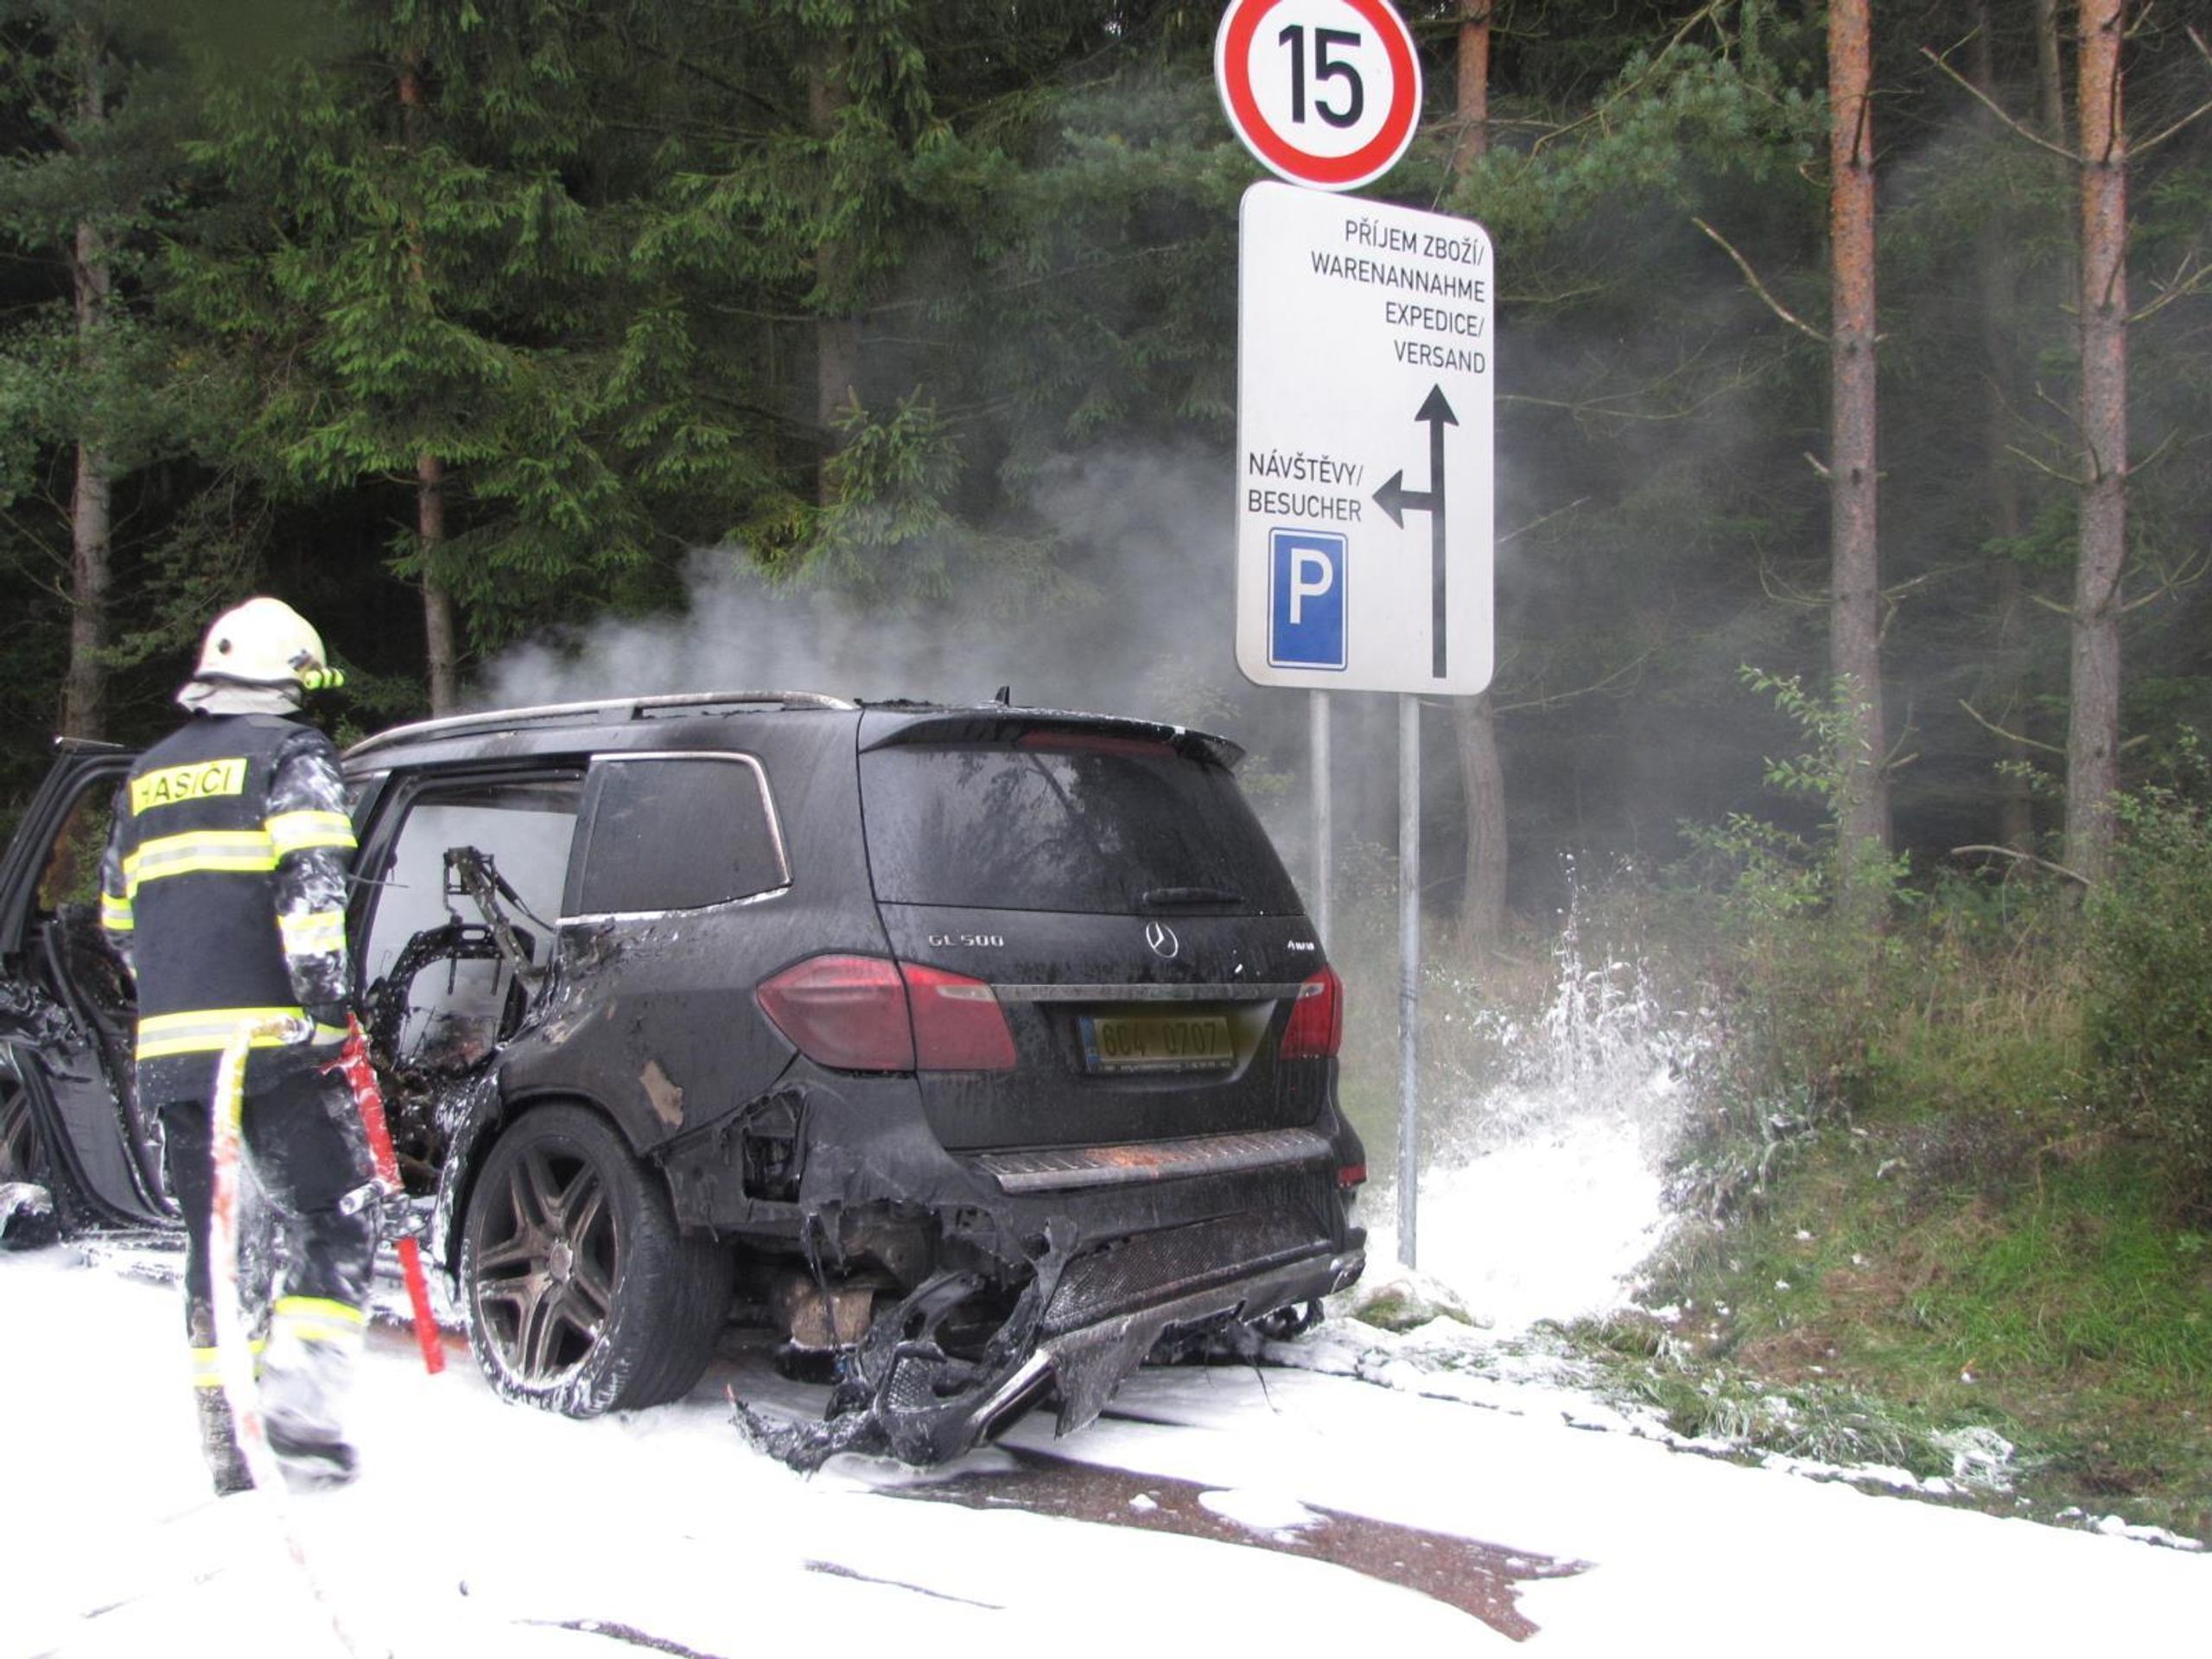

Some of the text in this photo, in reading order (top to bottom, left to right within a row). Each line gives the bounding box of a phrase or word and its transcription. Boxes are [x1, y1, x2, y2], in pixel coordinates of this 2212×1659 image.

[1279, 24, 1363, 129] 15
[1344, 216, 1484, 266] PŘÍJEM ZBOŽÍ/
[1311, 251, 1486, 303] WARENANNAHME
[1385, 302, 1484, 338] EXPEDICE/
[1394, 339, 1486, 375] VERSAND
[1249, 448, 1363, 486] NÁVŠTĚVY/
[1248, 489, 1362, 522] BESUCHER
[1289, 547, 1334, 624] P
[928, 934, 1005, 947] GL 500
[1161, 1021, 1217, 1054] 0707
